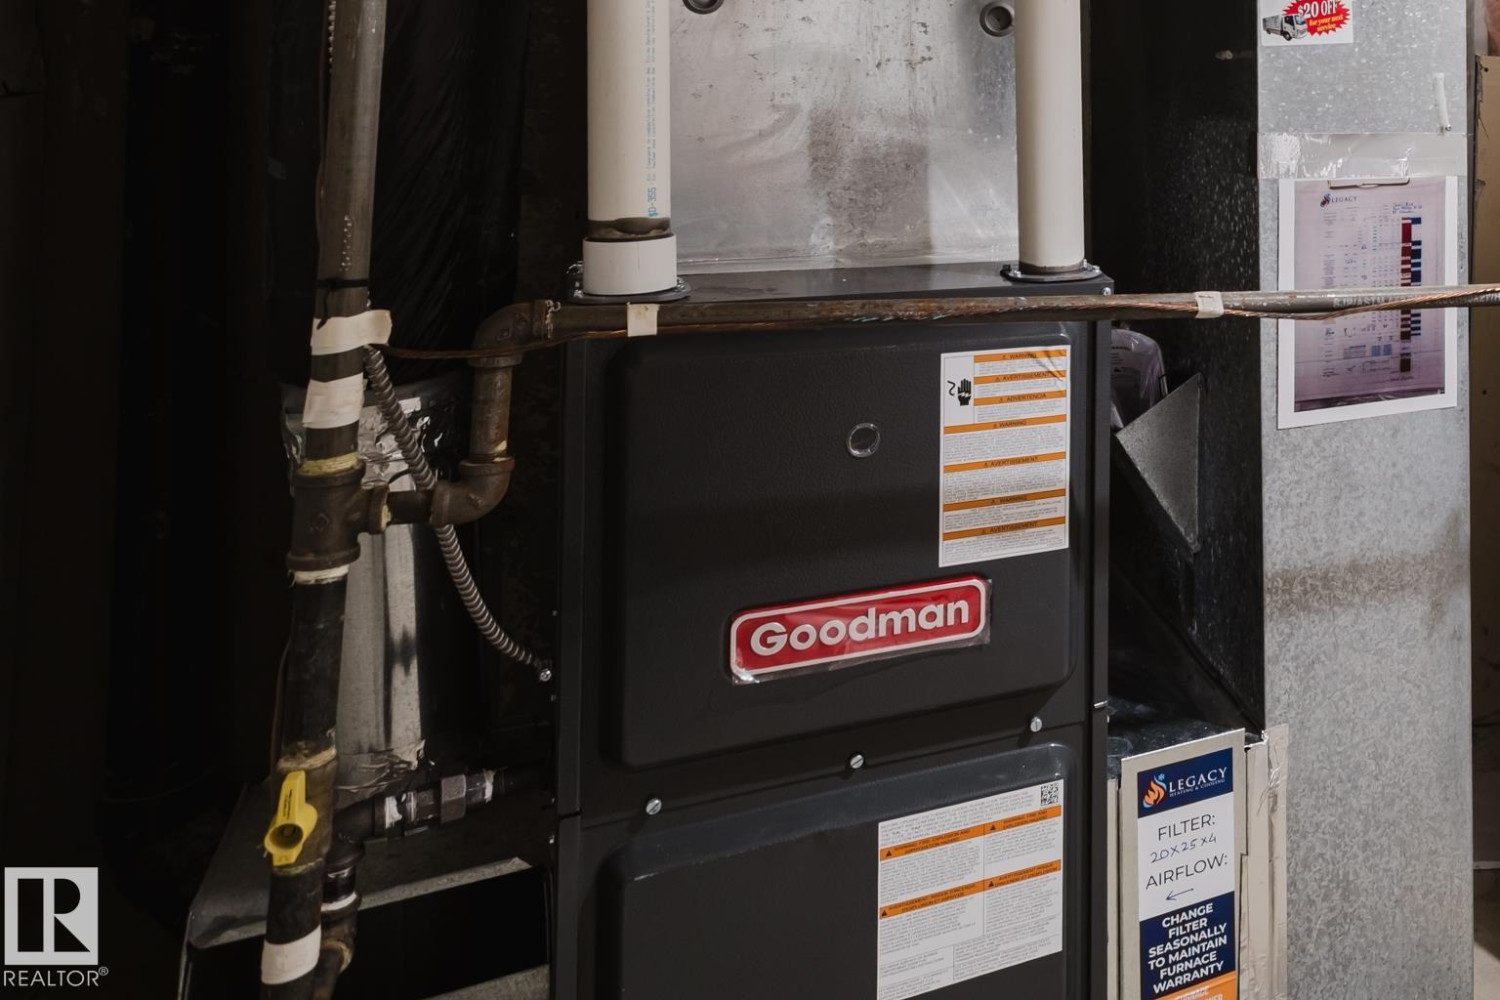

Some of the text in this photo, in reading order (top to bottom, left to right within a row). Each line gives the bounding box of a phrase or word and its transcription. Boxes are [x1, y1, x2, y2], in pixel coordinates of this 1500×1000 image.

[1297, 0, 1319, 18] $20
[750, 599, 969, 656] Goodman
[1169, 767, 1228, 793] LEGACY
[1158, 813, 1216, 841] FILTER:
[1145, 853, 1228, 890] AIRFLOW:
[1162, 902, 1214, 928] CHANGE
[1168, 918, 1208, 939] FILTER
[1148, 922, 1227, 958] SEASONALLY
[1148, 935, 1228, 971] TO MAINTAIN
[1153, 961, 1224, 994] WARRANTY
[1160, 951, 1217, 980] FURNACE
